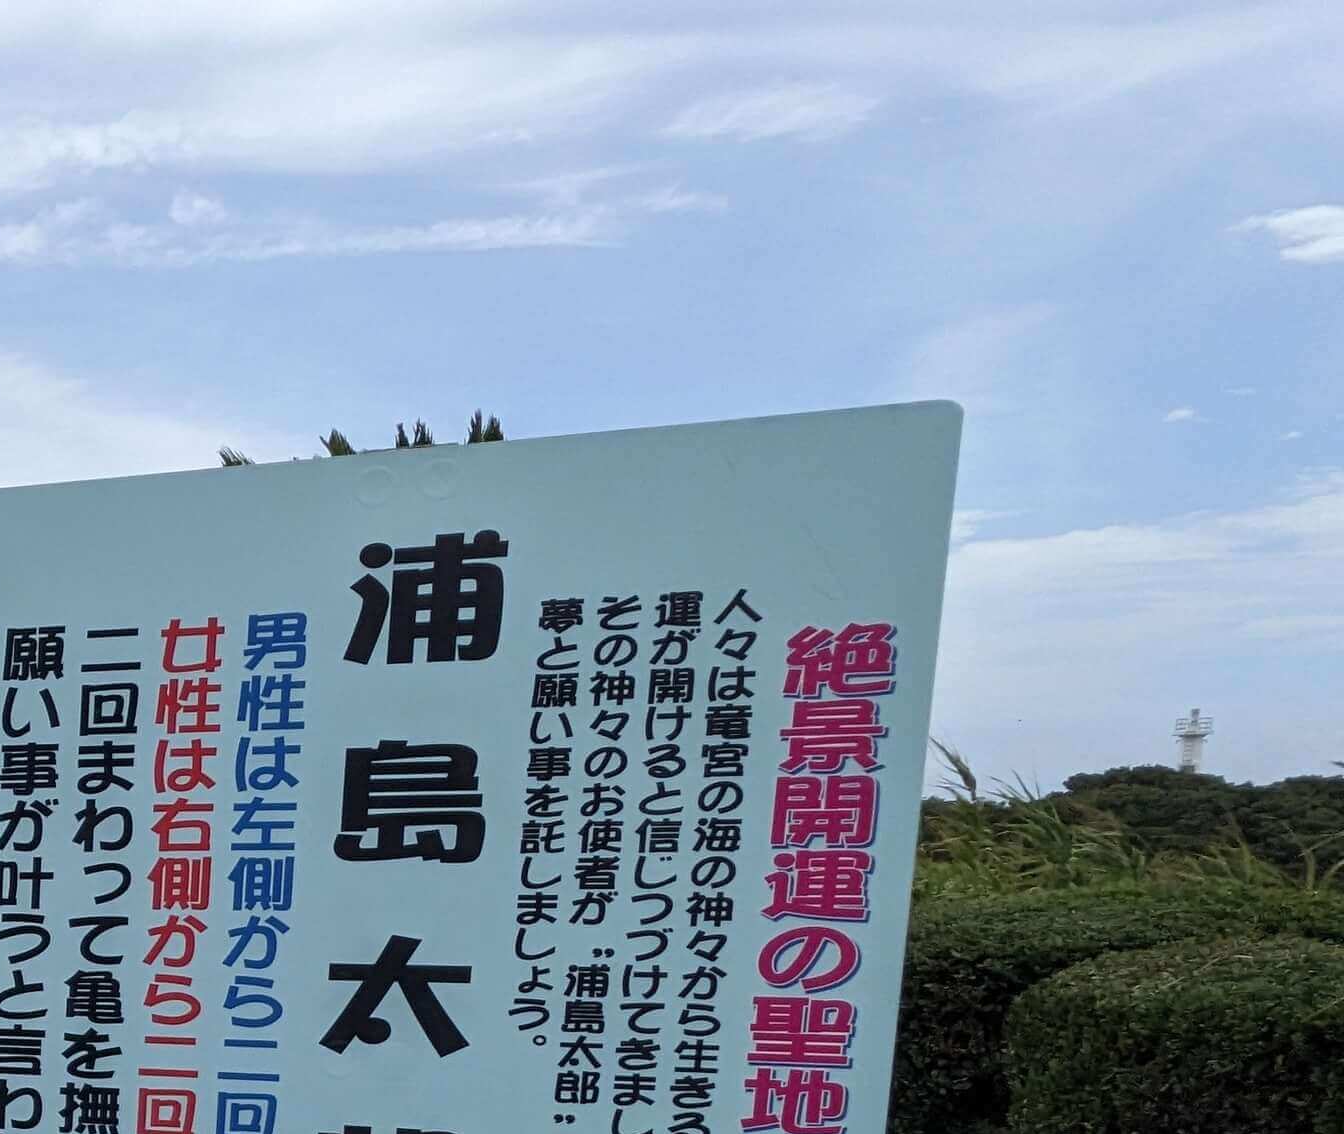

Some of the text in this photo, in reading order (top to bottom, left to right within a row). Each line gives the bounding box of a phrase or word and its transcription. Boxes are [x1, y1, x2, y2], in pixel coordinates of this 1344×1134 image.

[508, 598, 584, 1046] 夢と願い事を託しましょう。
